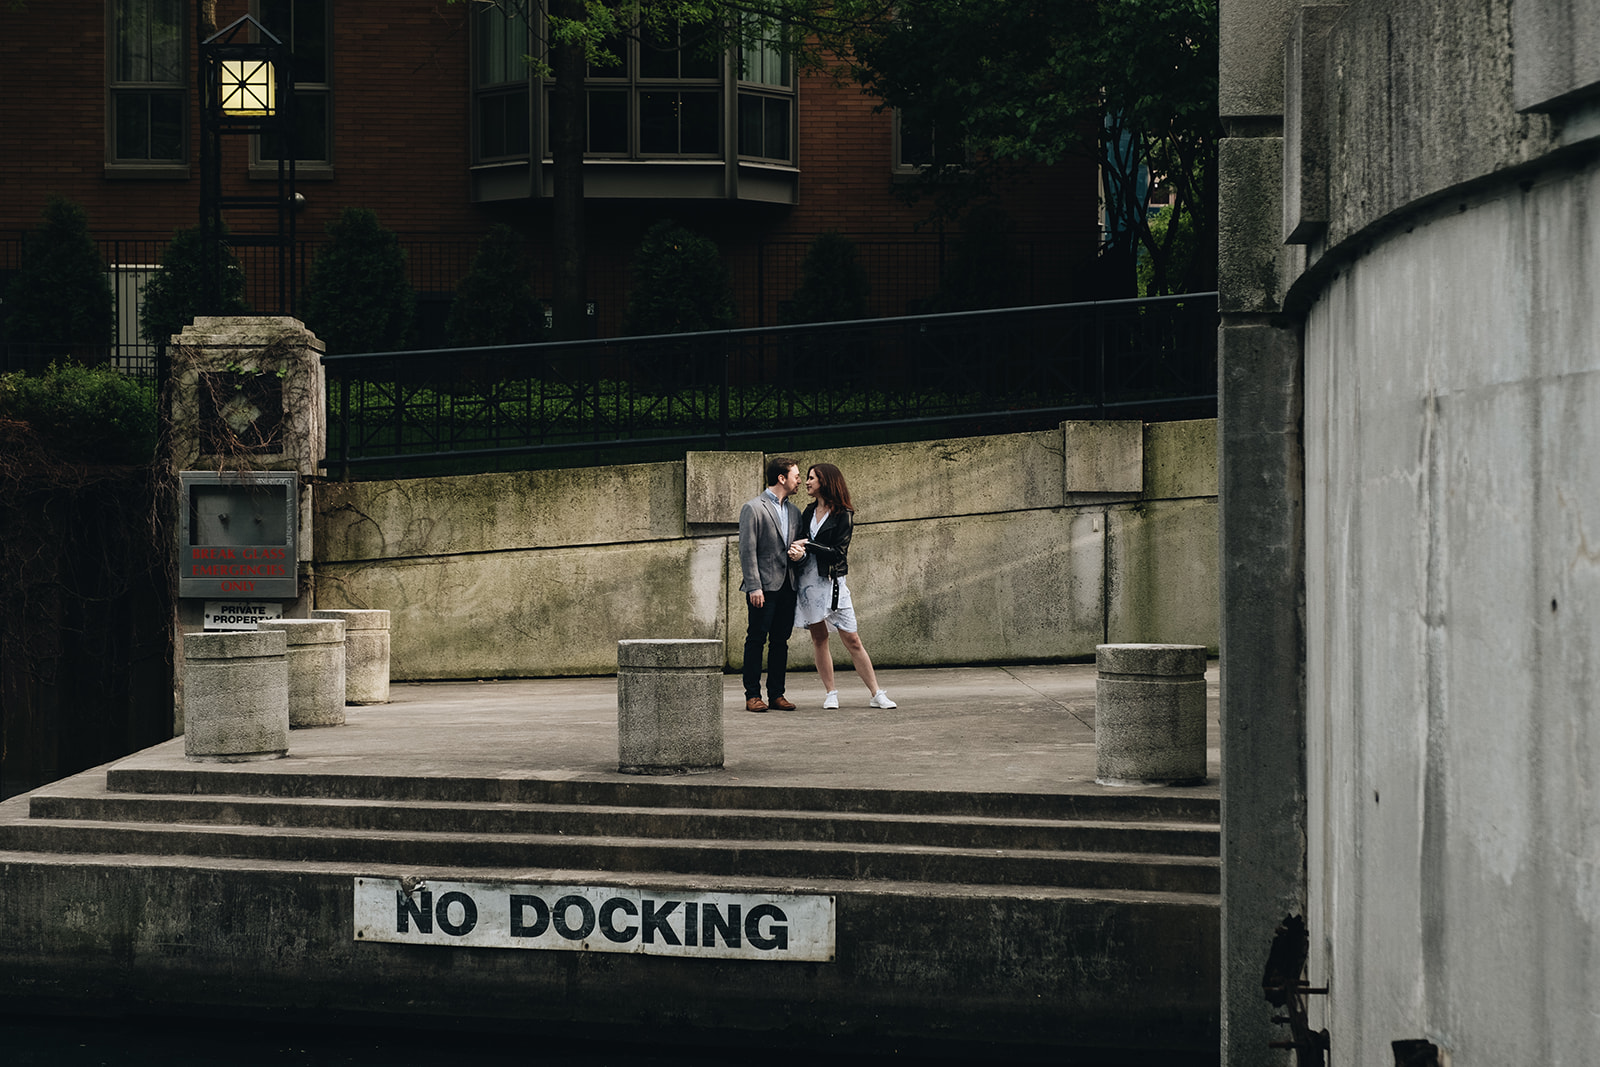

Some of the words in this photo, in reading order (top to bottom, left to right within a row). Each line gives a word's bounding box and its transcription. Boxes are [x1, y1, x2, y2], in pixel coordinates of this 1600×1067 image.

[192, 548, 236, 560] BREAK
[242, 548, 286, 560] GLASS
[192, 564, 286, 576] EMERGENCIES
[220, 580, 257, 592] ONLY
[221, 605, 266, 615] PRIVATE
[396, 889, 479, 937] NO
[509, 893, 789, 951] DOCKING
